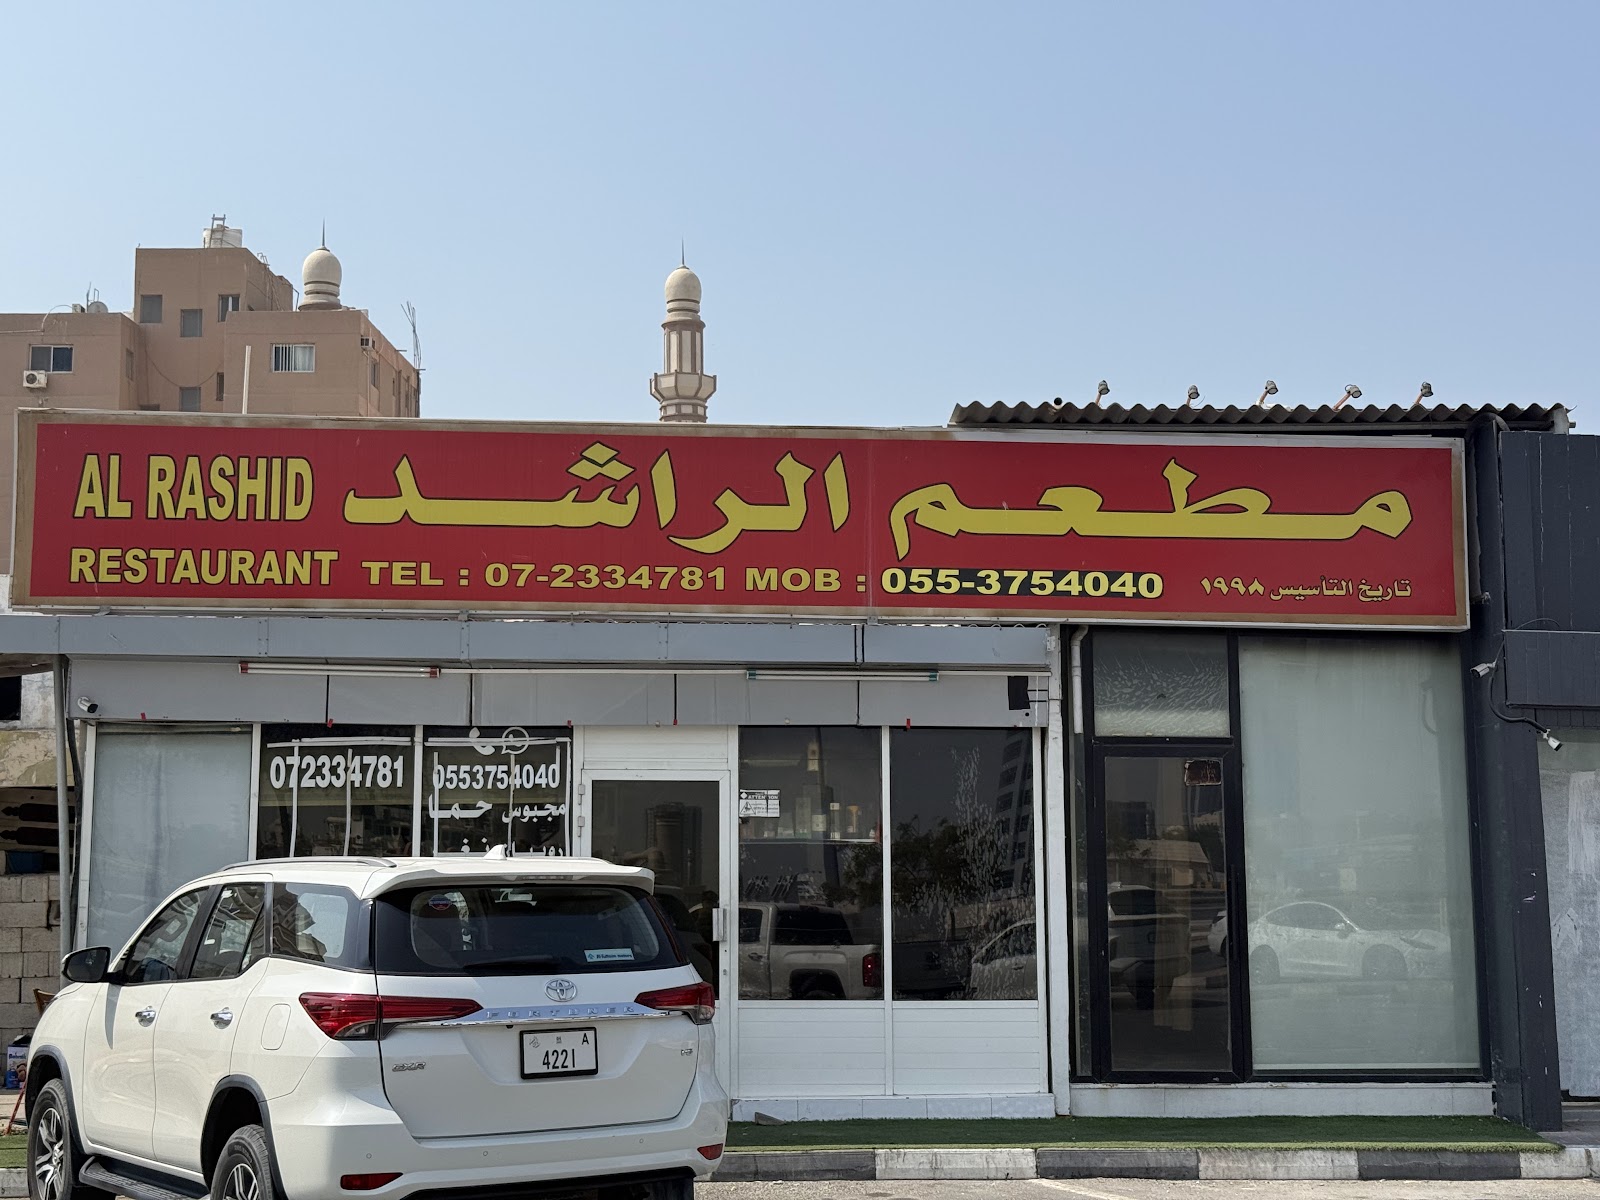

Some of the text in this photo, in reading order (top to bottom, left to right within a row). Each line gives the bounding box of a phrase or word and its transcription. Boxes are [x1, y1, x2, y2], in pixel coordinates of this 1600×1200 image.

[73, 453, 314, 521] AL RASHID
[343, 441, 1413, 562] مطعم الراشد
[68, 546, 340, 586] RESTAURANT
[361, 560, 445, 588] TEL
[484, 562, 727, 591] 07-2334781
[744, 566, 842, 593] MOB
[880, 567, 1164, 599] 055-3754040
[1268, 574, 1355, 602] التأسيس
[1356, 578, 1413, 603] تاريخ
[270, 755, 404, 789] 072334781
[432, 764, 560, 789] 0553754040
[486, 1005, 635, 1020] FORTUNER
[581, 1032, 590, 1046] A
[542, 1048, 576, 1070] 4221
